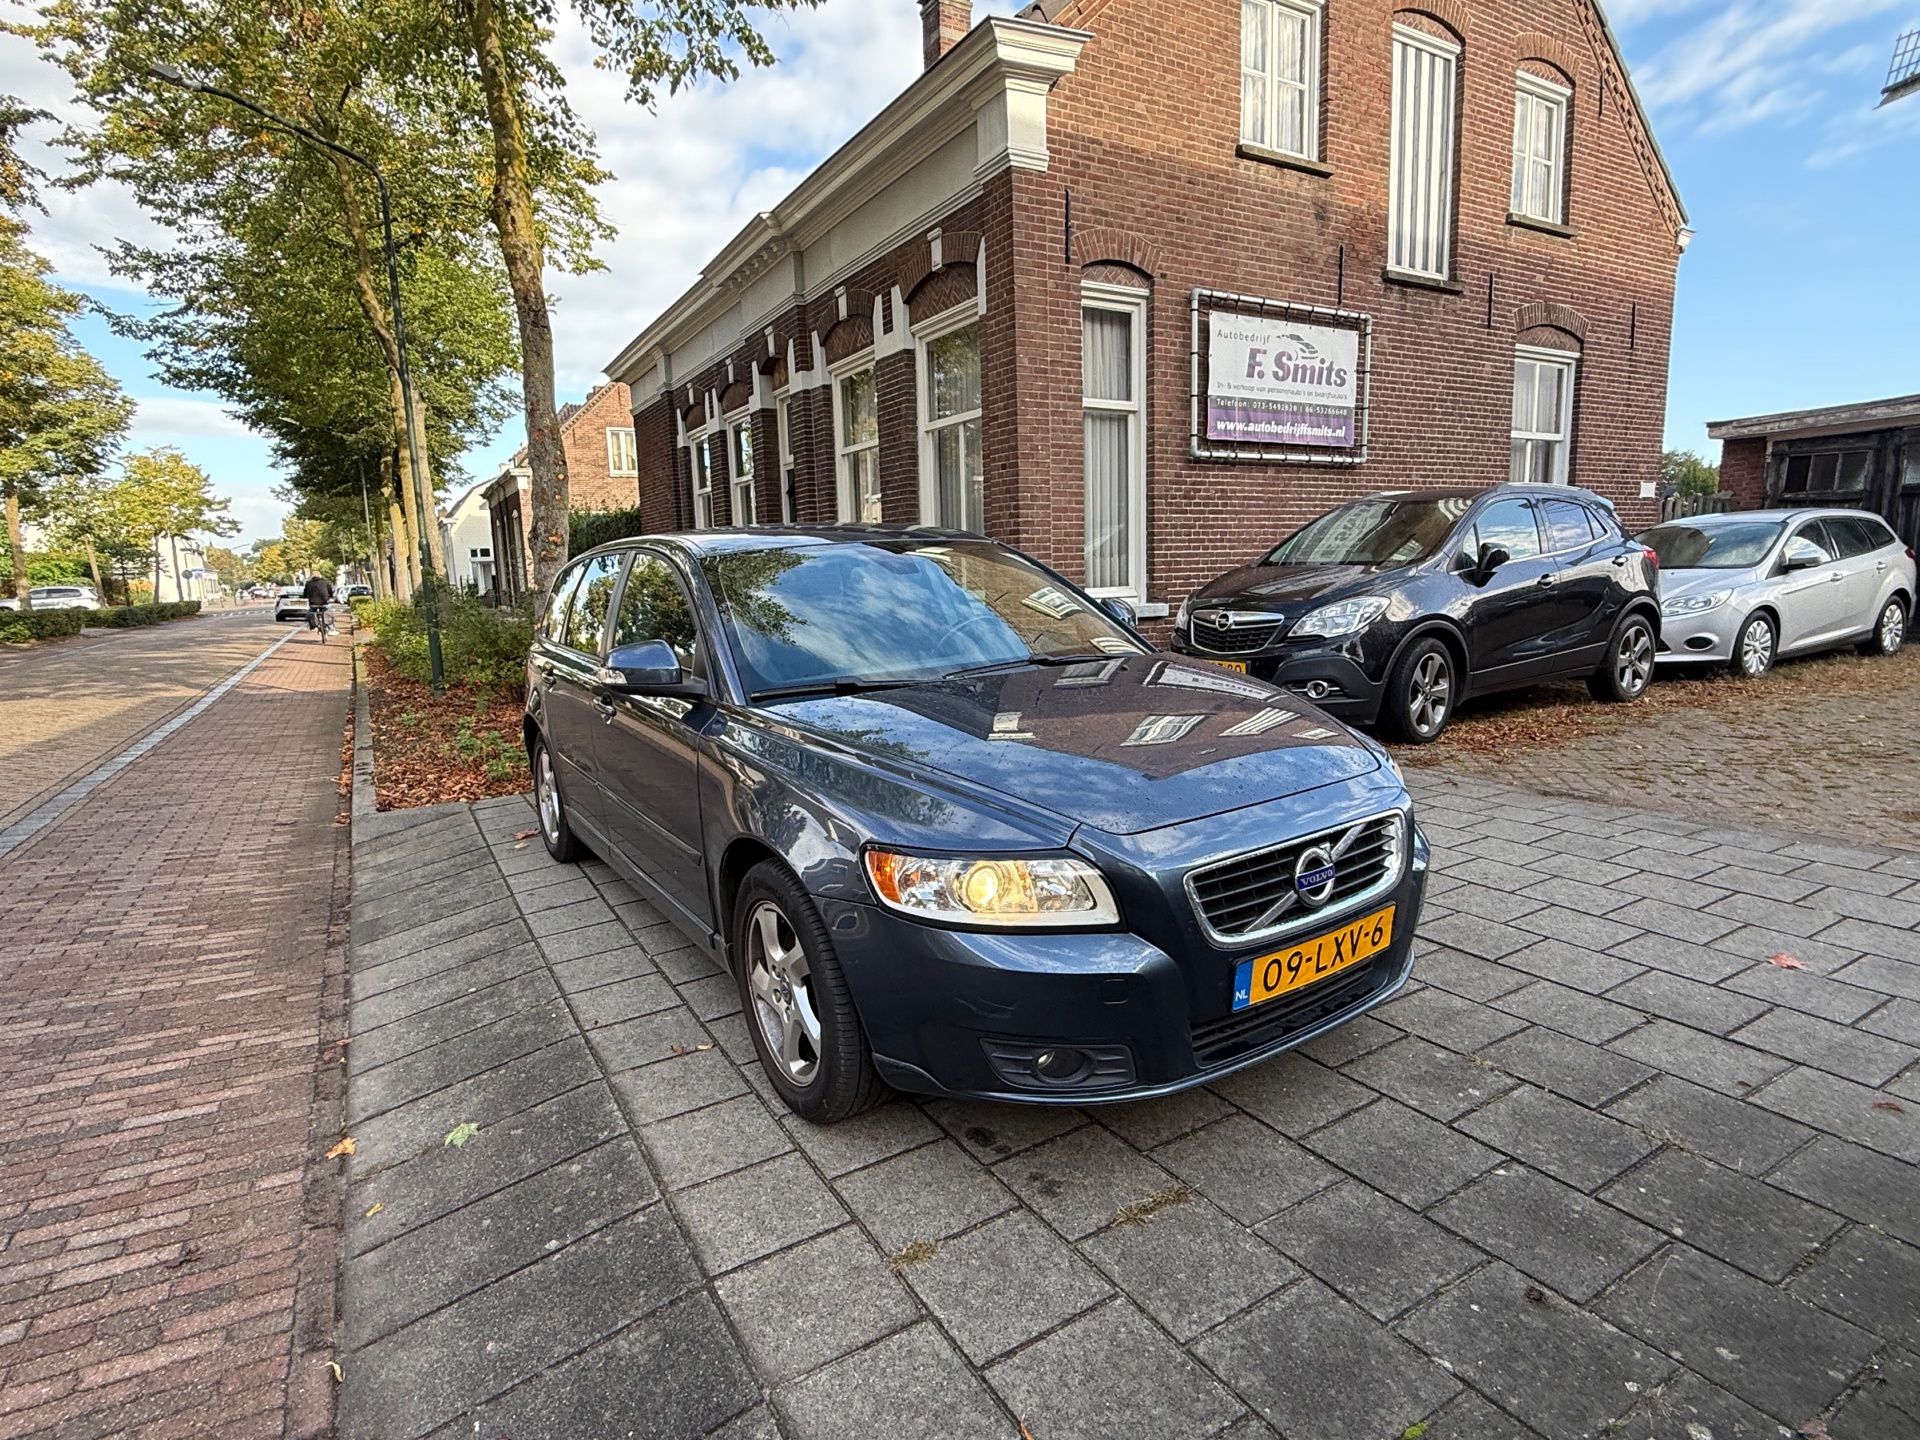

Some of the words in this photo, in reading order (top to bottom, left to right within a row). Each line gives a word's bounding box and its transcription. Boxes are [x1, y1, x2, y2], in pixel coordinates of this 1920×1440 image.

[1217, 329, 1271, 345] Autobedrijf
[1246, 347, 1267, 380] F.
[1272, 351, 1347, 388] Smits
[1233, 384, 1256, 392] verkoop
[1216, 398, 1250, 408] Telefoon:
[1216, 420, 1346, 438] www.autobedrijffsmits.nl
[1301, 869, 1334, 886] VOLVO
[1262, 915, 1384, 992] 09-LXV-6
[1235, 988, 1249, 1002] NL
